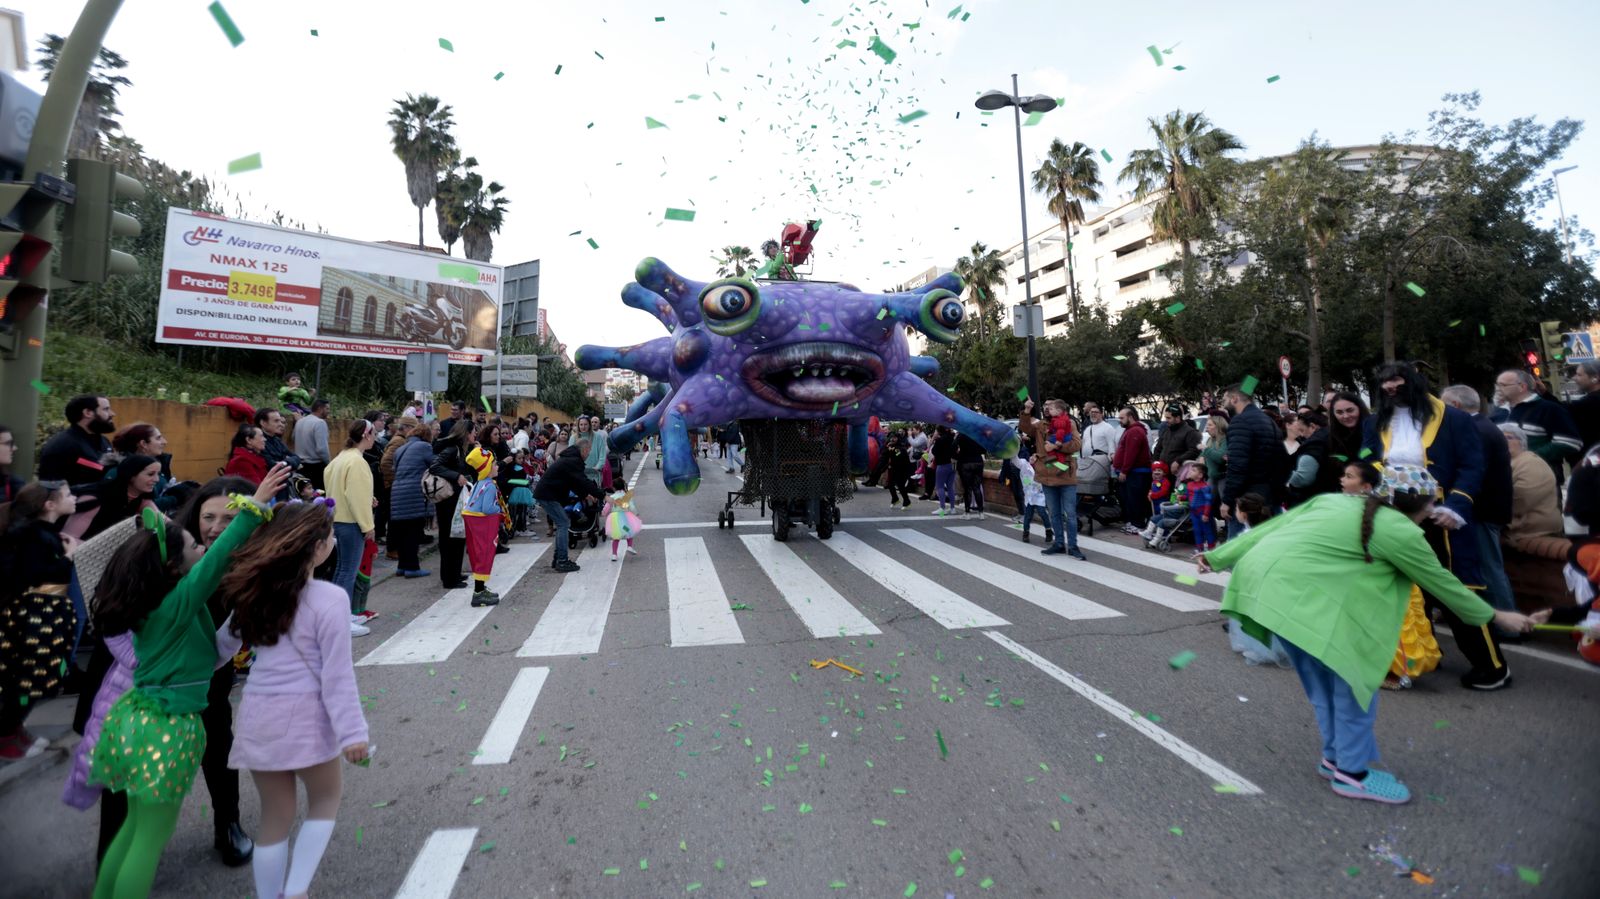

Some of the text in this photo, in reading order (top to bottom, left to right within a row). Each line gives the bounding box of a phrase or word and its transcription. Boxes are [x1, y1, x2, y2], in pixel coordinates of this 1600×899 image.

[226, 236, 320, 259] Navarro Hnos.
[210, 253, 288, 273] NMAX 125
[181, 275, 228, 290] Precio:
[231, 281, 273, 298] 3.749€
[211, 296, 235, 306] AÑOS
[237, 300, 249, 308] DE
[176, 307, 308, 327] DISPONIBILIDAD INMEDIATA
[265, 337, 288, 345] JEREZ
[310, 340, 346, 350] FRONTERA
